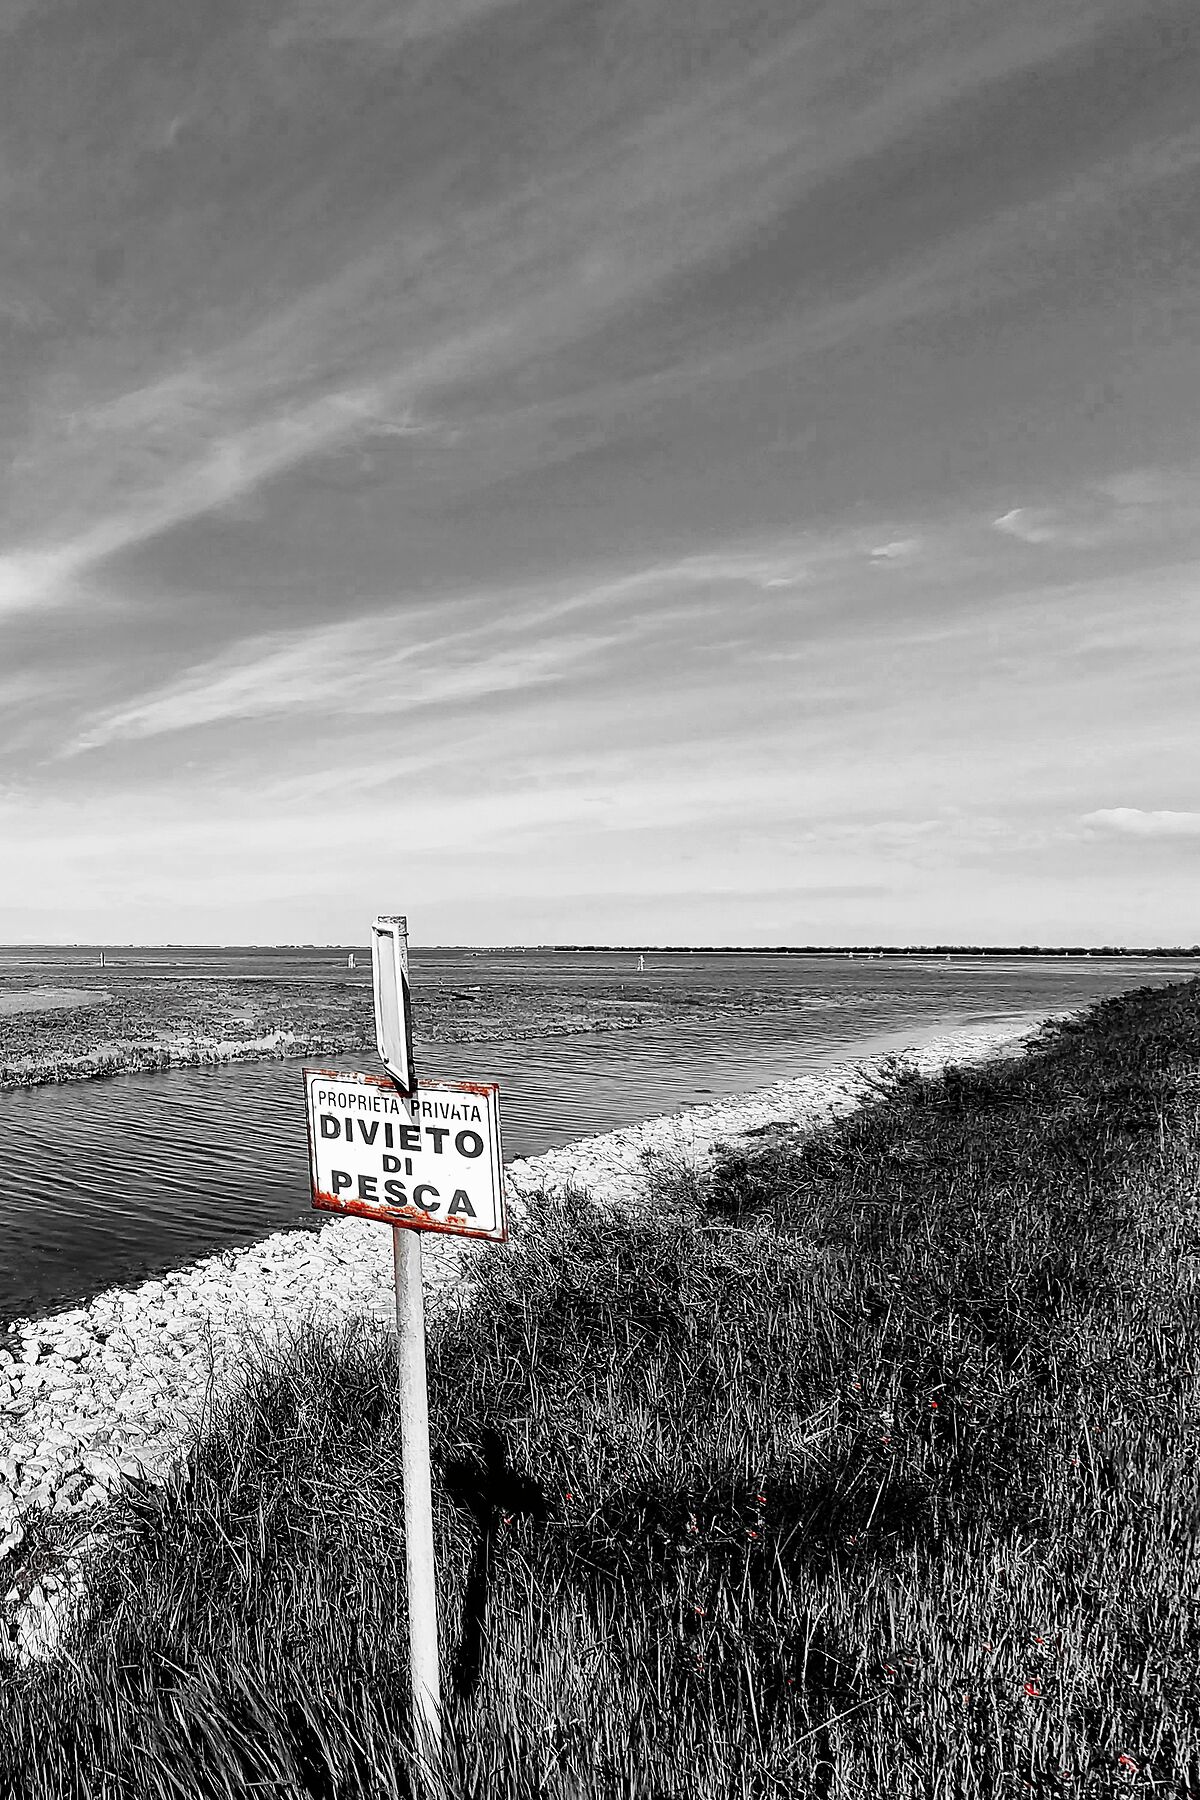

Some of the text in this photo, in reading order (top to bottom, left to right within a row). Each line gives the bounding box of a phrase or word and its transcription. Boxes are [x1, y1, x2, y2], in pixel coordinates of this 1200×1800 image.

[411, 1099, 482, 1122] PRIVATA
[320, 1114, 484, 1158] DIVIETO
[382, 1154, 413, 1175] DI
[331, 1169, 477, 1218] PESCA
